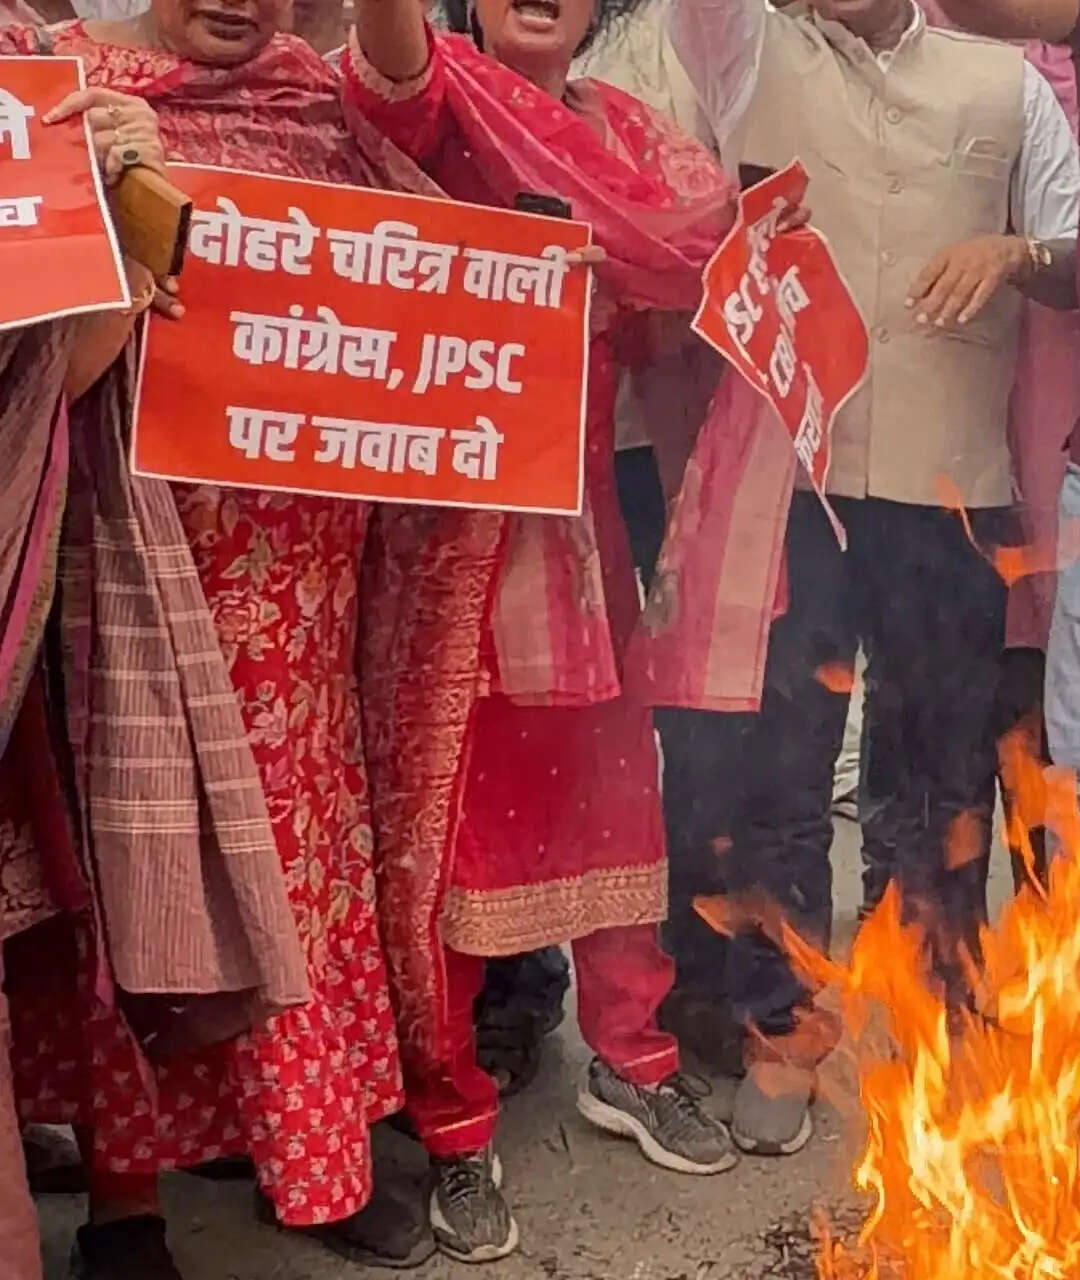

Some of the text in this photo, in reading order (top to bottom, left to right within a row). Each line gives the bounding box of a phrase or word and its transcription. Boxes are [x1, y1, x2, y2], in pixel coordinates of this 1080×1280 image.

[189, 198, 570, 309] दोहरे चरित्र वाली
[230, 305, 525, 394] कांग्रेस, JPSC
[226, 406, 503, 481] पर जवाब दो
